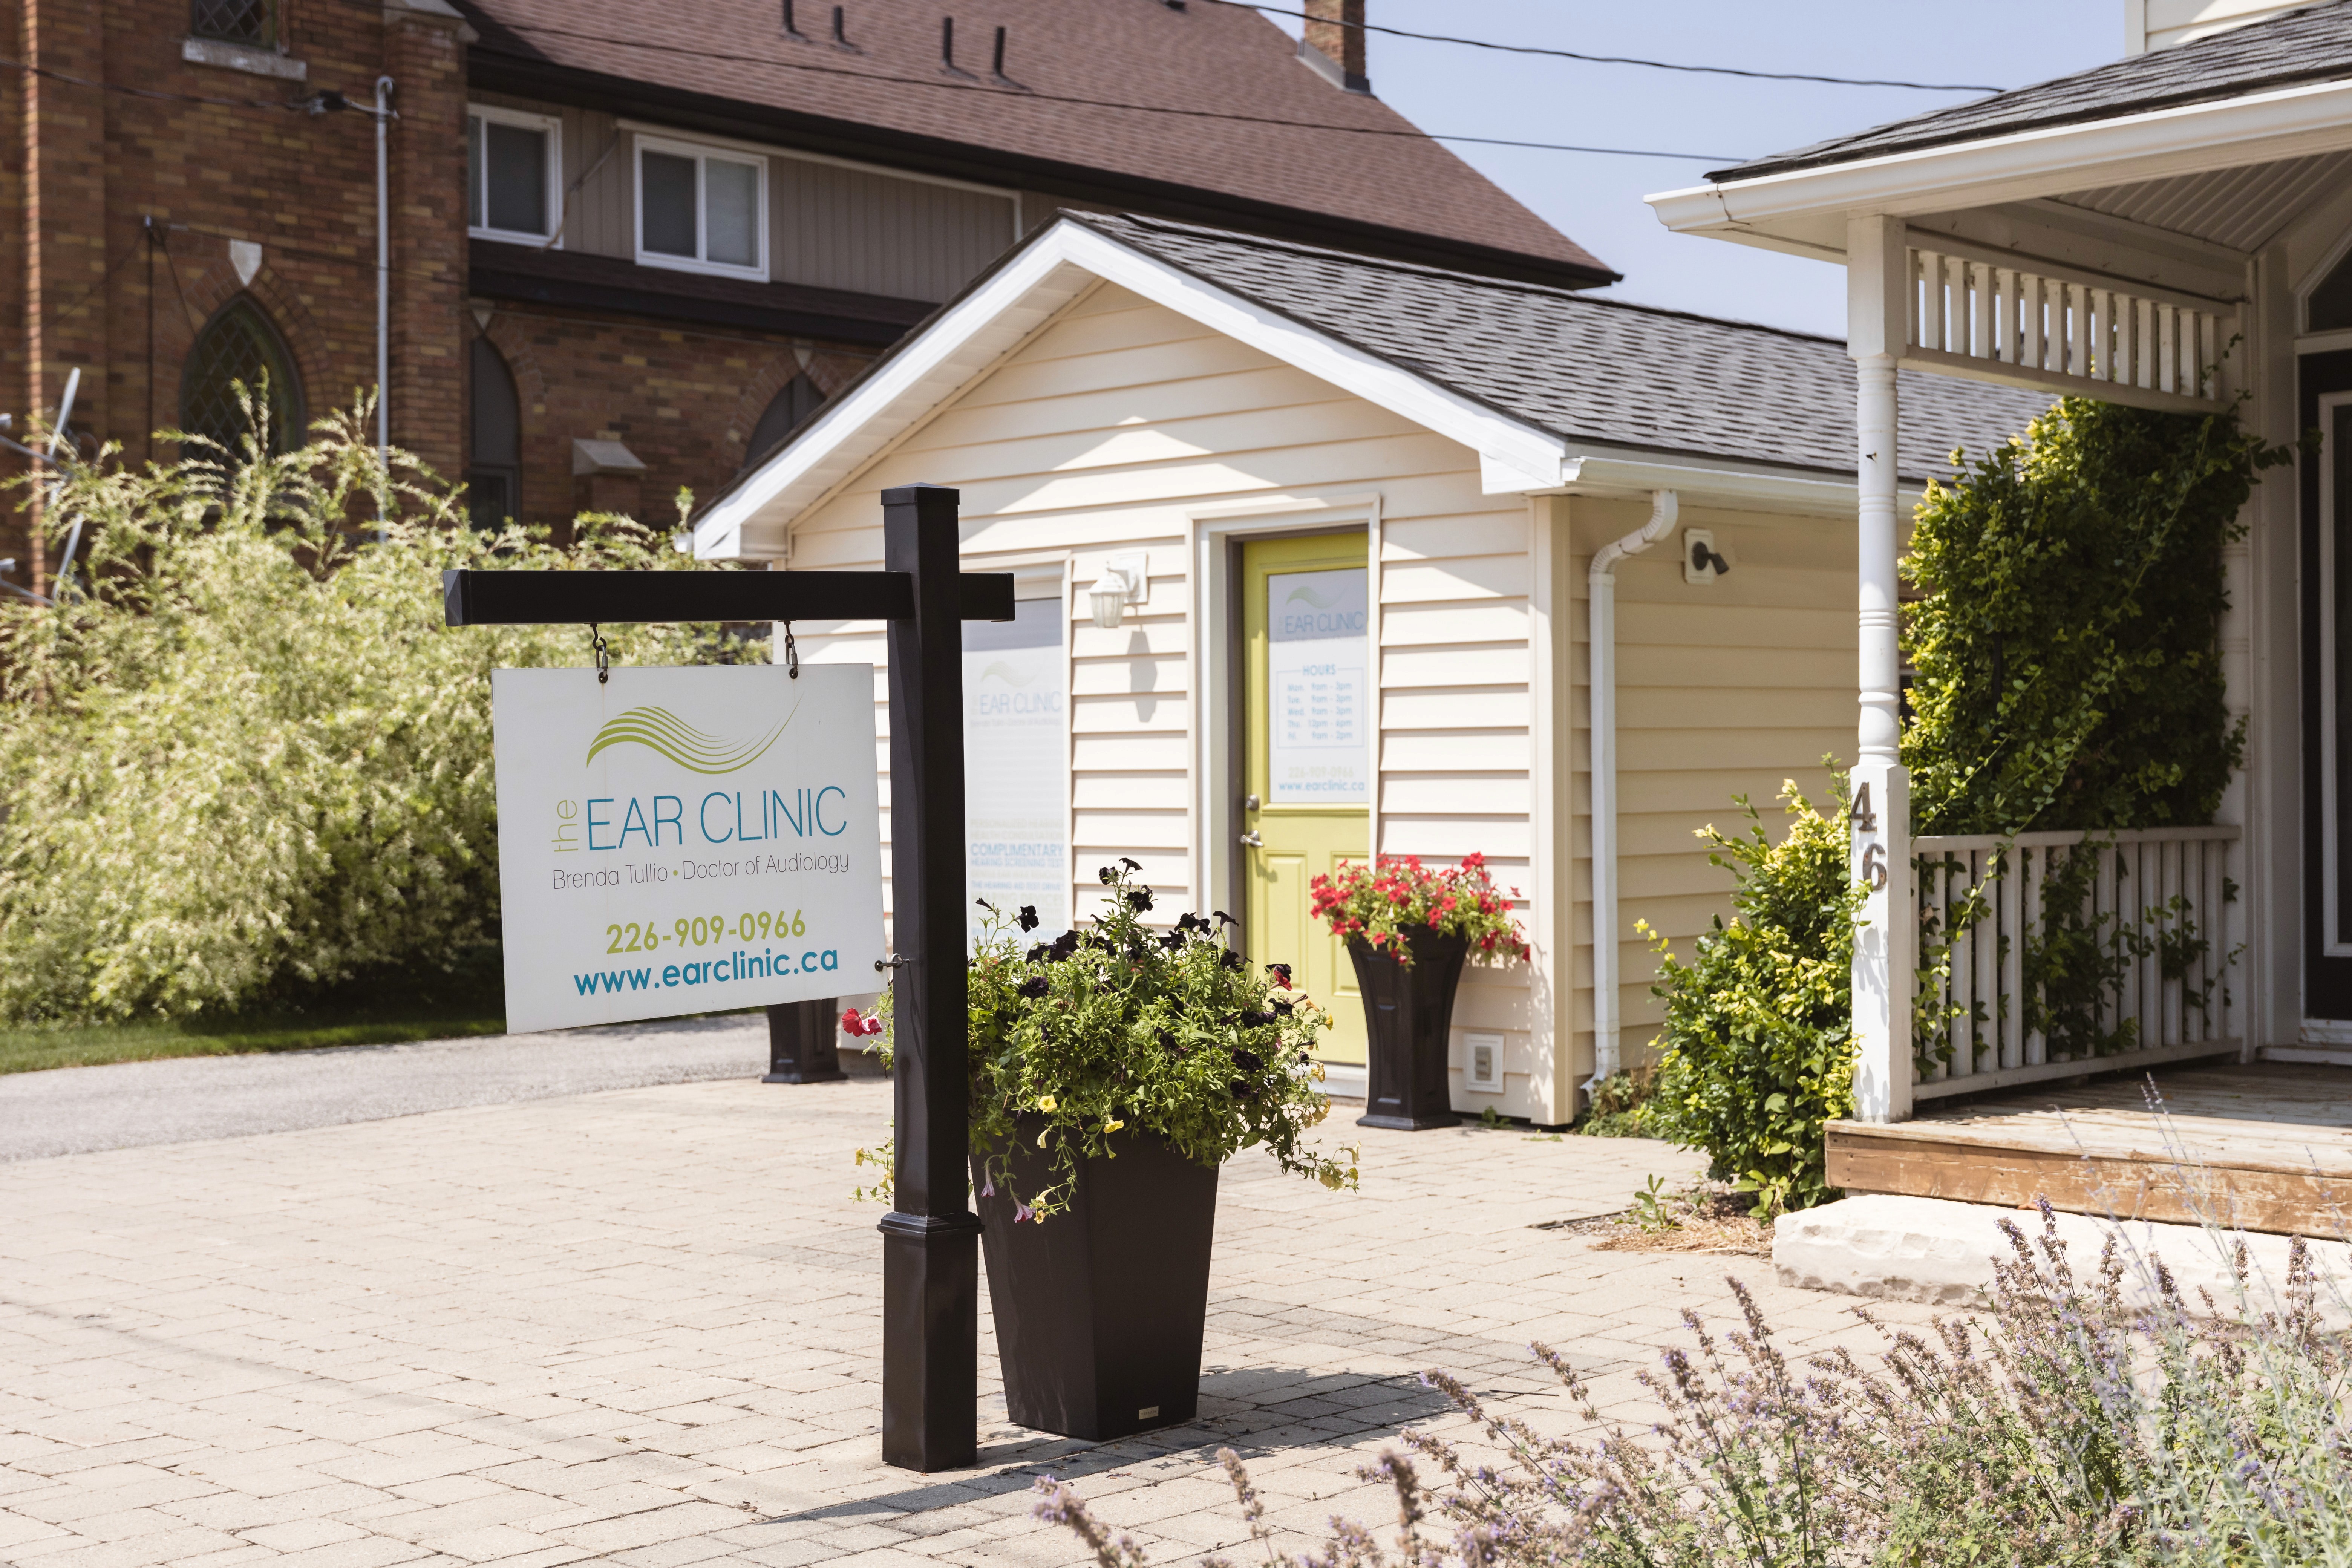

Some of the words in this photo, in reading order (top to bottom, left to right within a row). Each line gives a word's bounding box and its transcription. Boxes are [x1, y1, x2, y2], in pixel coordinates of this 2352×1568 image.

[1285, 614, 1314, 634] EAR
[1317, 611, 1364, 632] CLINIC
[1302, 664, 1337, 675] HOURS
[980, 694, 1010, 715] EAR
[1013, 691, 1062, 714] CLINIC
[1279, 779, 1365, 791] www.earclinic.ca
[551, 799, 579, 852] the
[587, 795, 683, 851] EAR
[700, 786, 847, 844] CLINIC
[1850, 782, 1887, 891] 46
[970, 843, 1064, 856] COMPLIMENTARY
[553, 866, 619, 890] Brenda
[625, 863, 668, 884] Tullio
[683, 860, 739, 880] Doctor
[745, 855, 761, 875] of
[766, 852, 849, 874] Audiology
[606, 908, 806, 954] 226-909-0966
[573, 947, 838, 996] www.earclinic.ca
